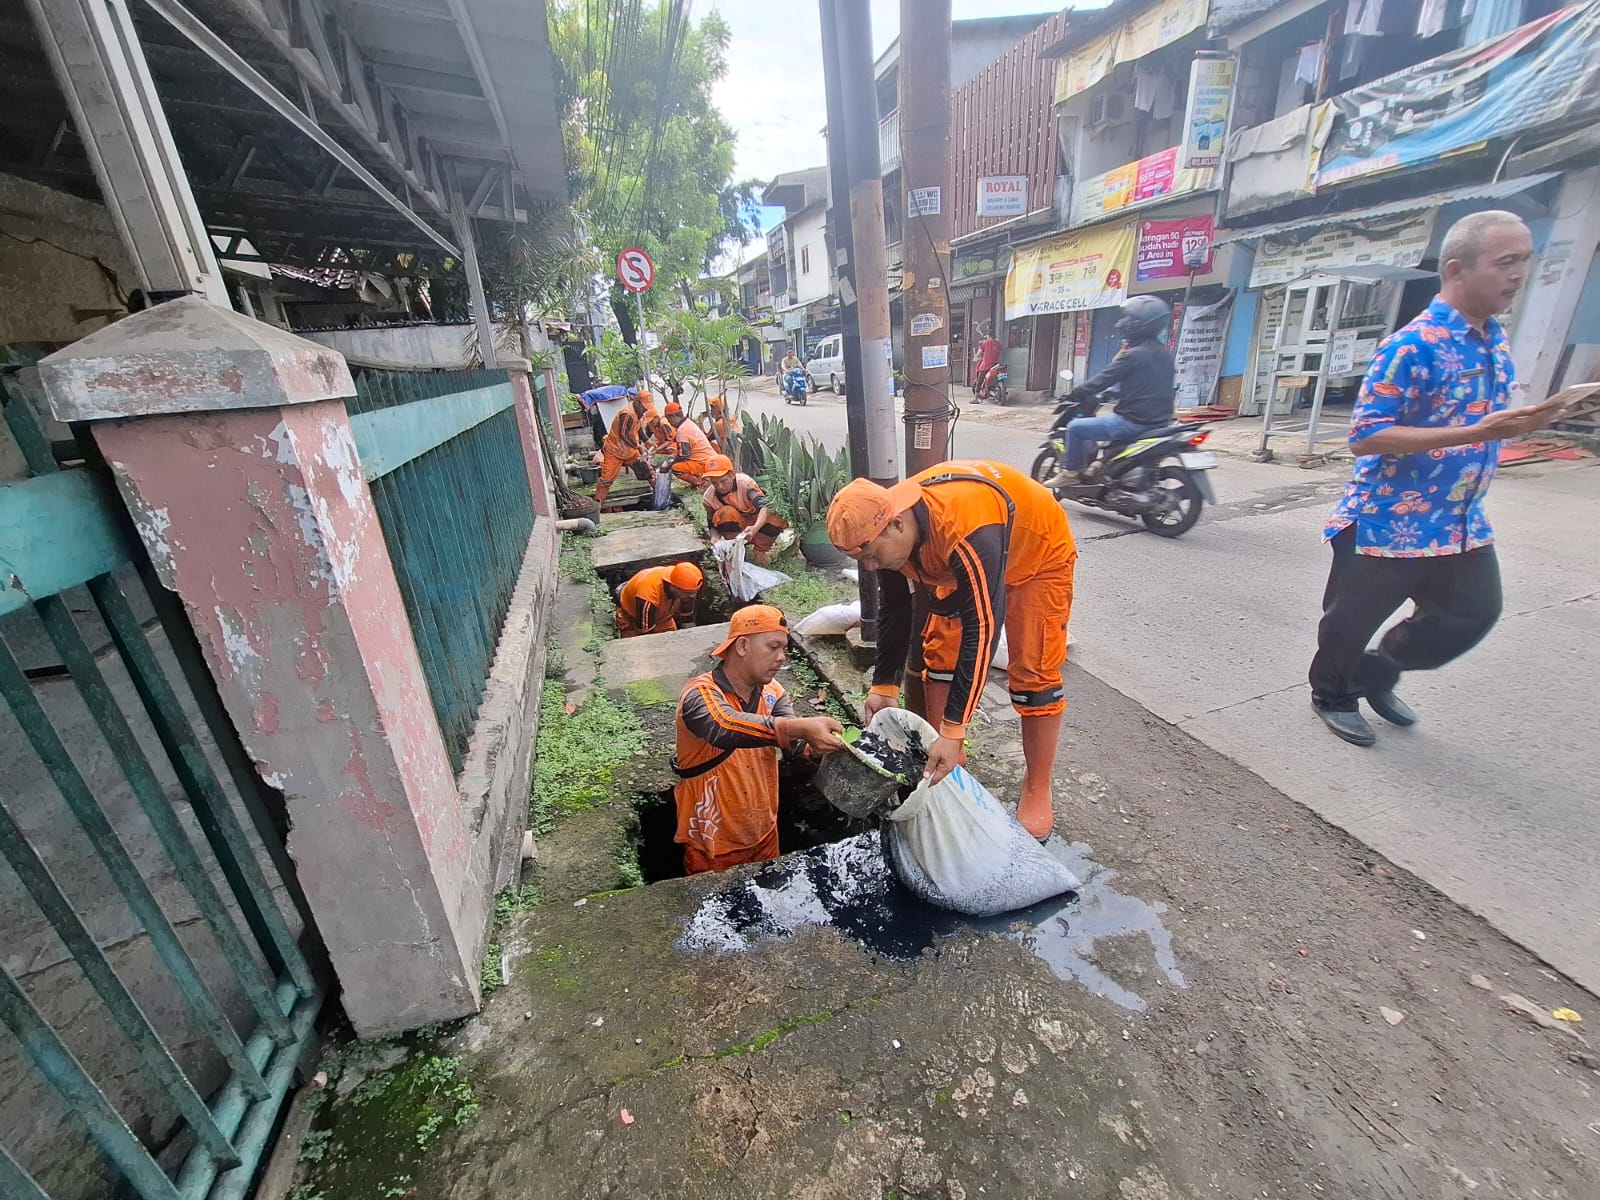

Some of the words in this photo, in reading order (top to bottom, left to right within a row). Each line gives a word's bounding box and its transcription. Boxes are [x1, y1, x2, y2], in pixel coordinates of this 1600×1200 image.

[985, 181, 1023, 193] ROYAL
[1139, 233, 1170, 242] aringan
[1162, 241, 1180, 249] hadir
[1147, 250, 1164, 259] Area
[1165, 249, 1174, 257] ini
[1066, 297, 1088, 310] CELL
[1335, 353, 1347, 361] FULL
